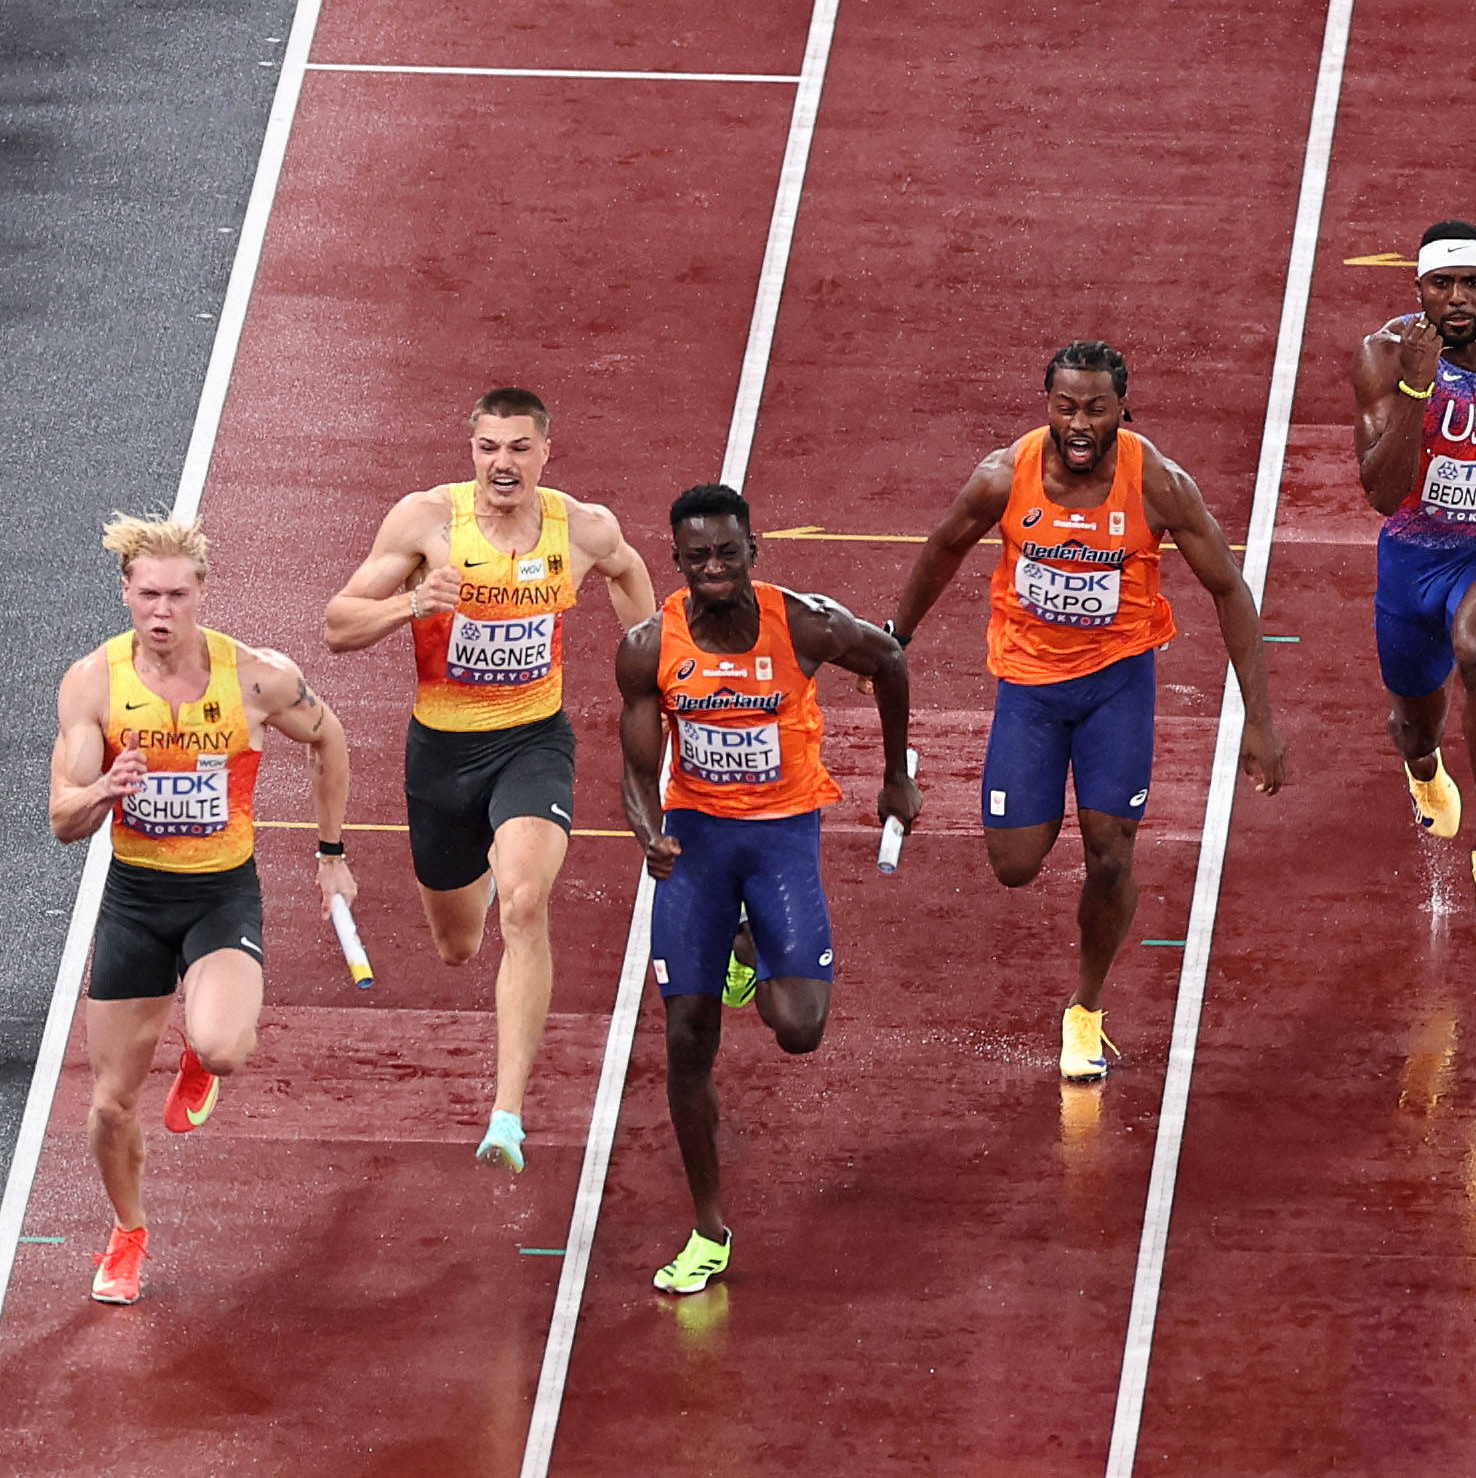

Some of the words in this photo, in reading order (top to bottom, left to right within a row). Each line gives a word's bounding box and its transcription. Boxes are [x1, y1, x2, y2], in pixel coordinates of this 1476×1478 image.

[1043, 568, 1111, 592] TDK
[459, 583, 561, 606] GERMANY
[1028, 583, 1103, 614] EKPO
[482, 618, 547, 642] TDK
[456, 643, 547, 667] WAGNER
[120, 728, 234, 750] GERMANY
[698, 726, 768, 748] TDK
[684, 741, 773, 769] BURNET
[147, 774, 218, 795] TDK
[127, 794, 221, 820] SCHULTE
